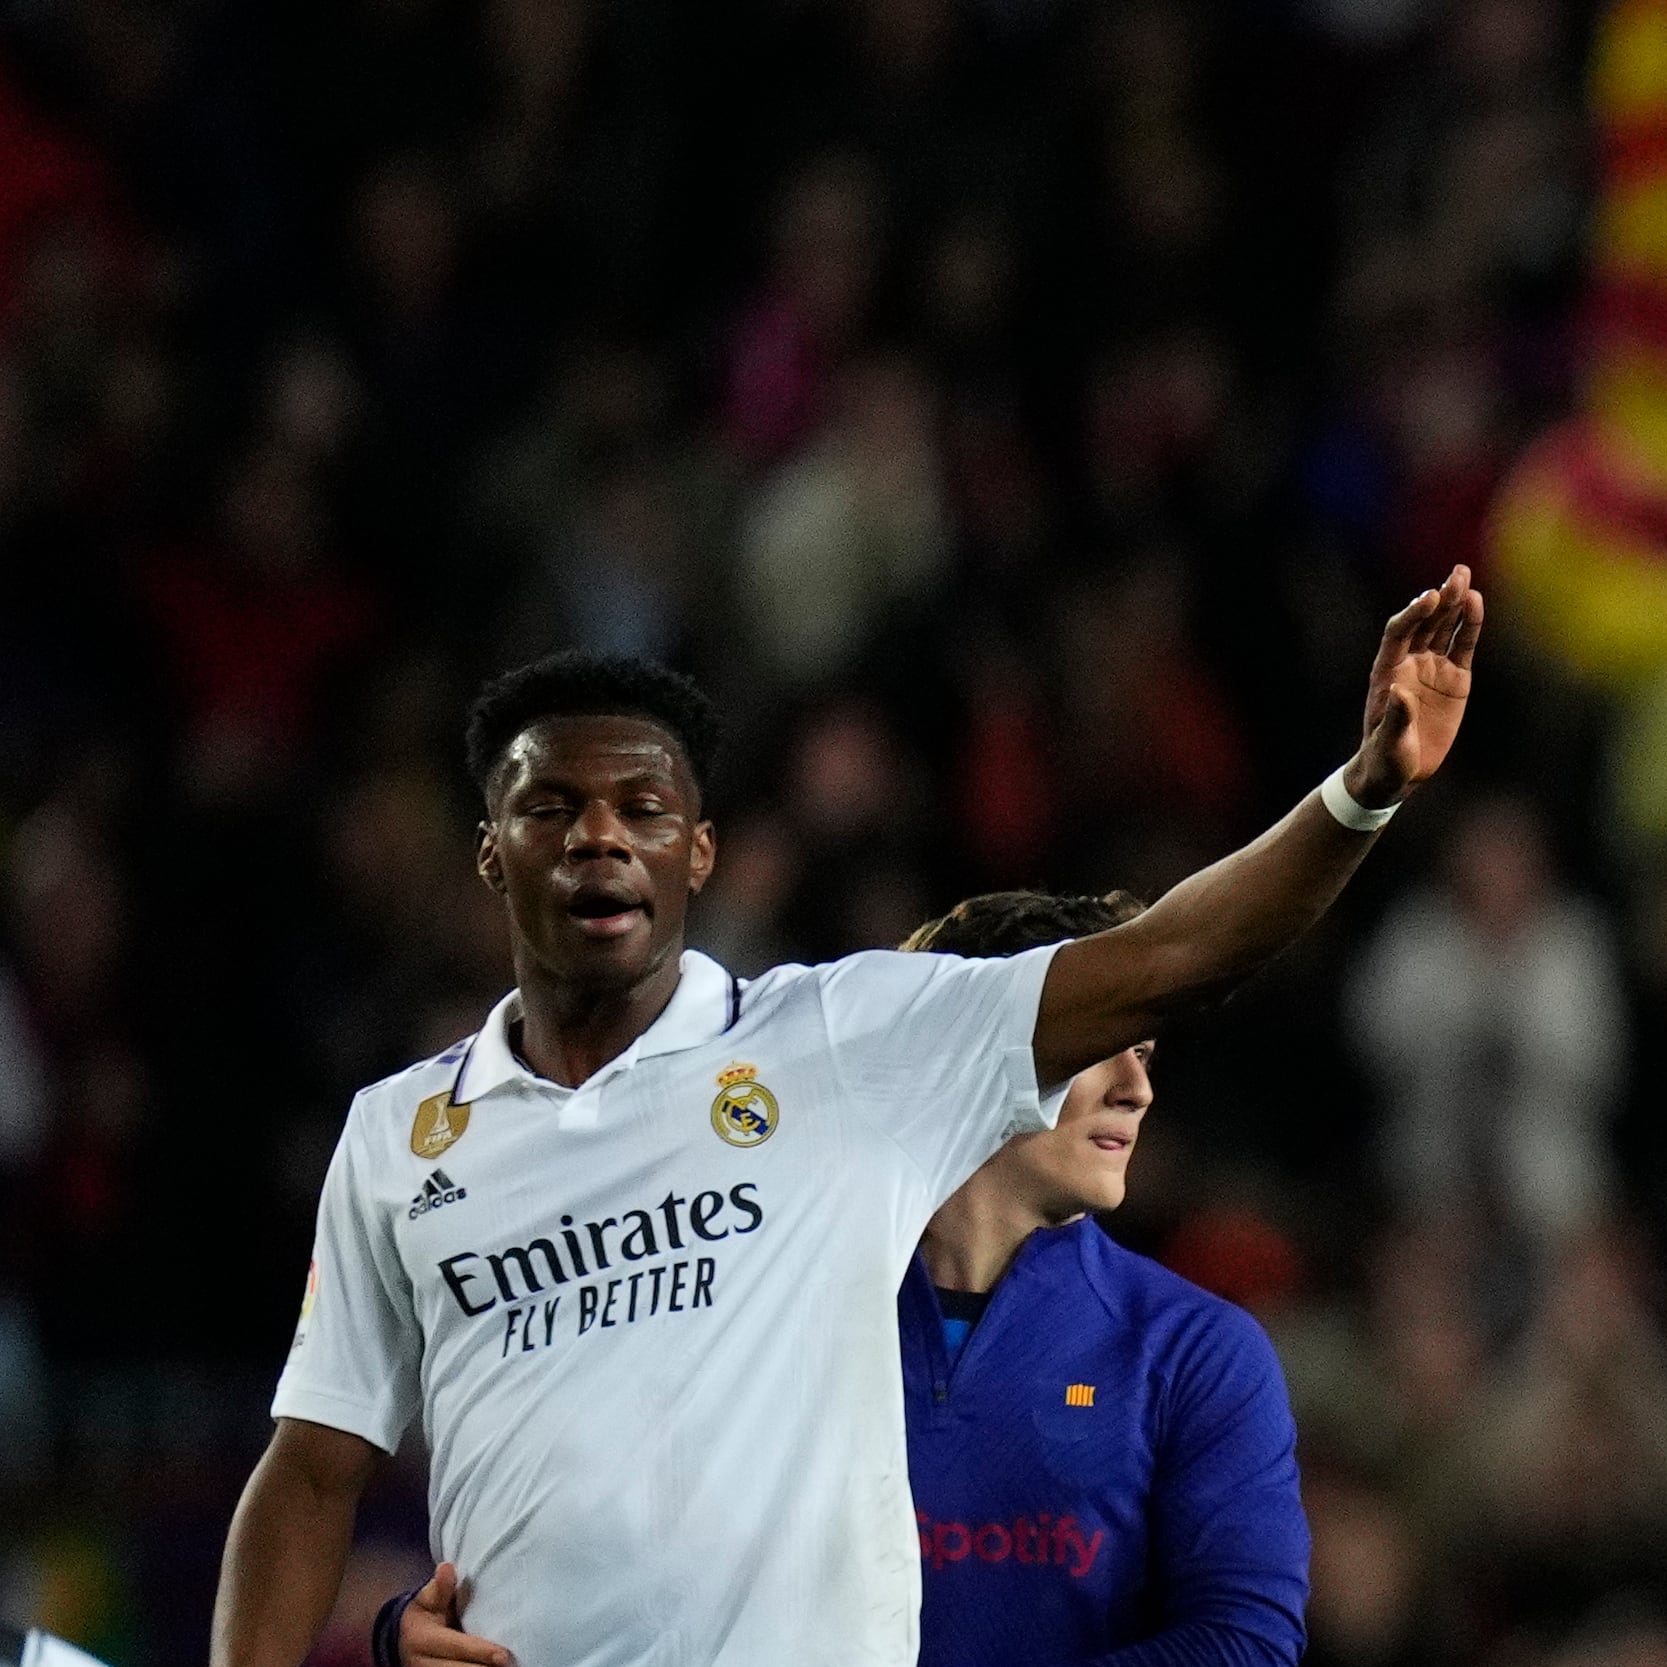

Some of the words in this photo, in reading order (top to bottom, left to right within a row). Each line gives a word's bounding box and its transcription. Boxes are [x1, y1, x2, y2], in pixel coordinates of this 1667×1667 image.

[409, 1188, 467, 1221] adidas
[438, 1182, 764, 1317] Emirates
[502, 1296, 560, 1358] FLY
[578, 1257, 718, 1335] BETTER
